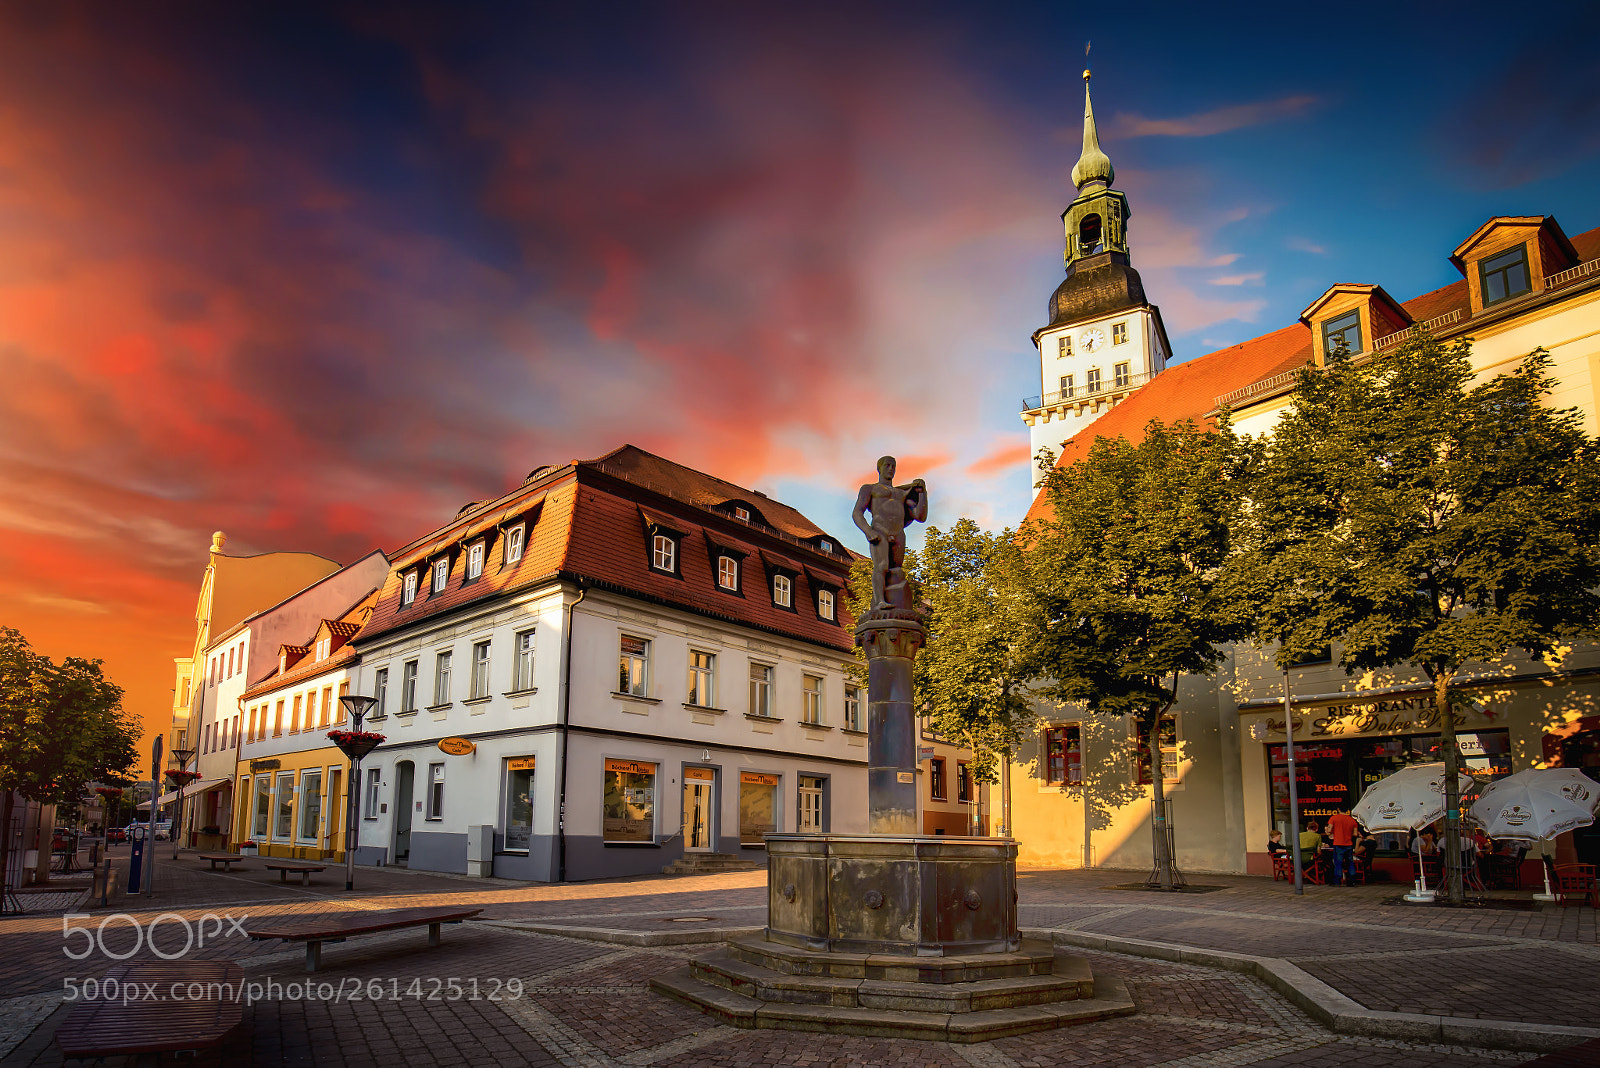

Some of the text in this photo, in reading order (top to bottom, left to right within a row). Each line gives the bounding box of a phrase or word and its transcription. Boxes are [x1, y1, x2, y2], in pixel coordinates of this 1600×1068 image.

[1328, 697, 1438, 717] RISTORANTE
[1311, 707, 1466, 736] La Dolce Va
[1315, 784, 1348, 793] Fisch
[1303, 808, 1352, 817] indisce
